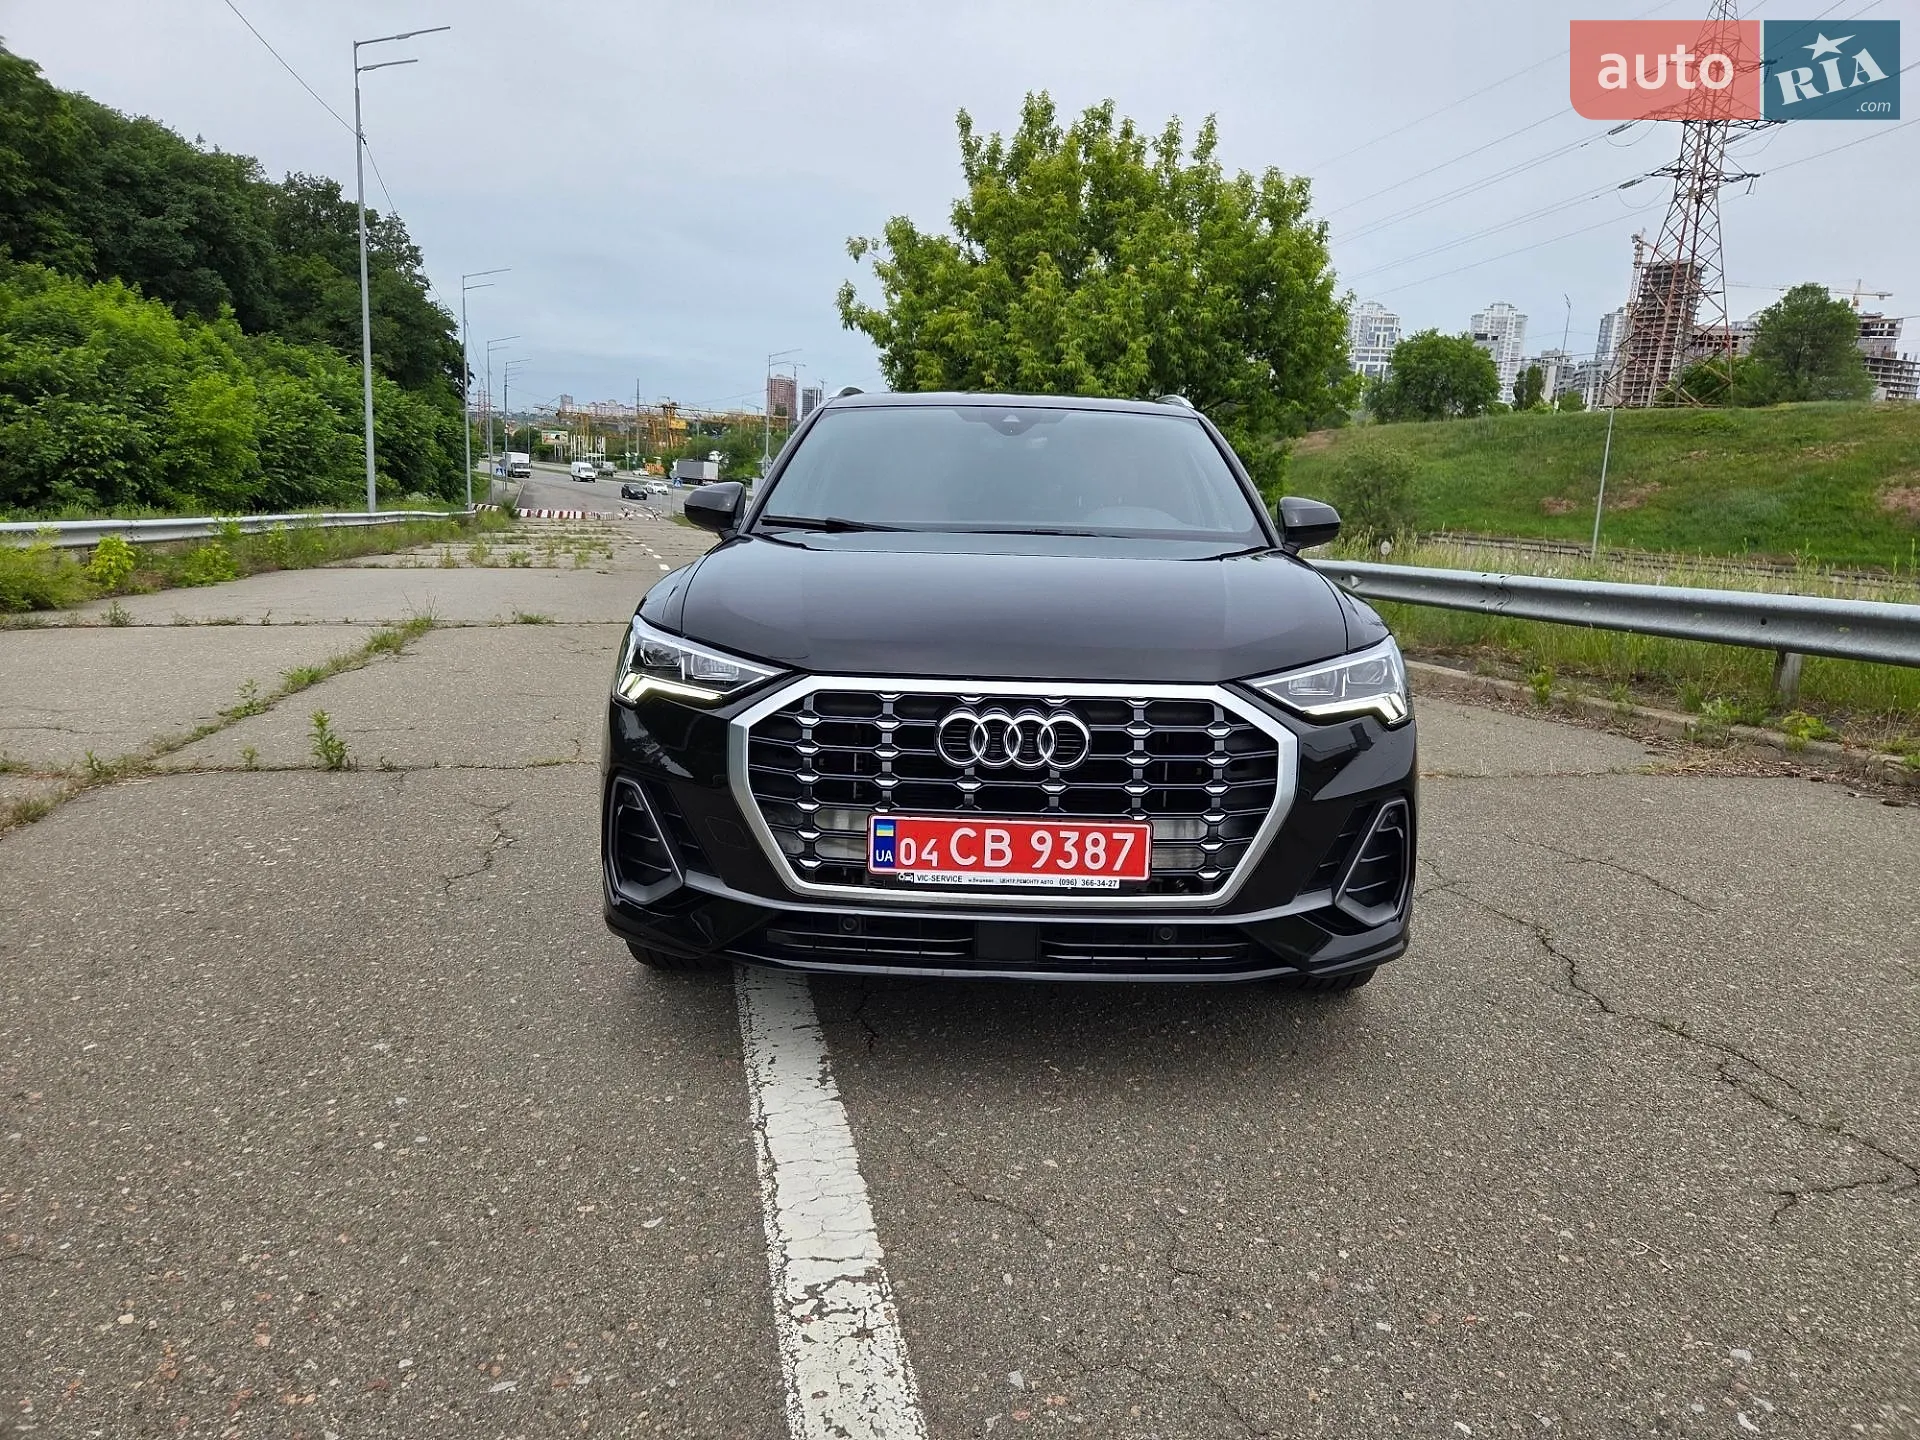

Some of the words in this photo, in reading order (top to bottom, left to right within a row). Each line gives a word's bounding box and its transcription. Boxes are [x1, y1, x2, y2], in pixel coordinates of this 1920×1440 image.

[876, 849, 893, 863] UA
[899, 837, 939, 867] 04
[949, 827, 1013, 868] CB
[1030, 829, 1135, 872] 9387
[917, 874, 963, 883] VIC-SERVICE
